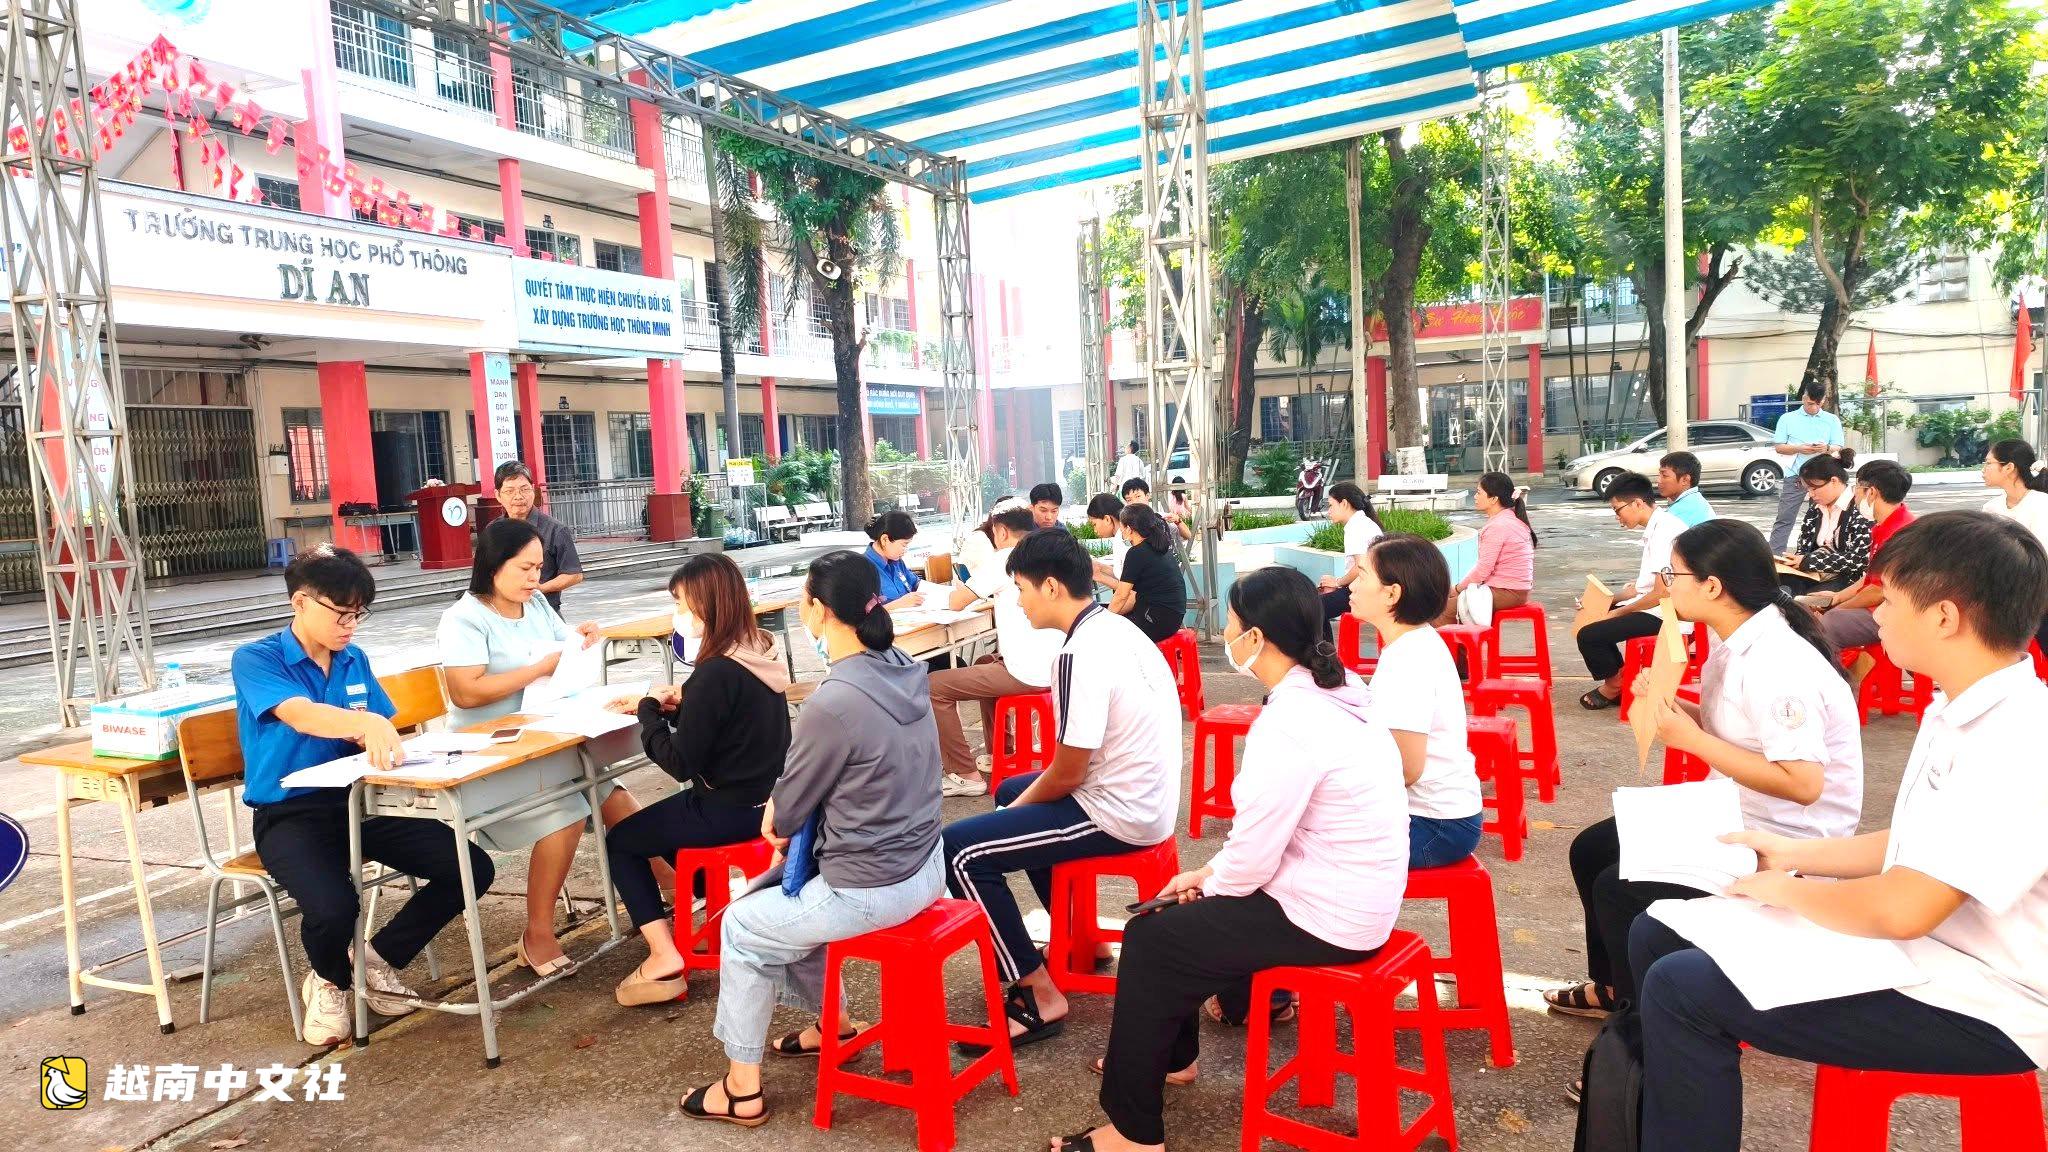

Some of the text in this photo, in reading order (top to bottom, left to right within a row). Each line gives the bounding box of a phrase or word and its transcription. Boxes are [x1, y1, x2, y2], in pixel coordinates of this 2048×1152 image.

[238, 224, 313, 255] TRUNG
[320, 236, 361, 264] HỌC
[409, 248, 467, 275] THÔNG
[326, 270, 370, 306] AN
[525, 277, 552, 298] QUYẾT
[555, 280, 573, 300] TÂM
[575, 285, 596, 305] THỰC
[598, 287, 616, 308] HIỆN
[533, 306, 671, 337] XÂY DỰNG TRƯỜNG HỌC THÔNG MINH
[102, 724, 147, 736] BIWASE
